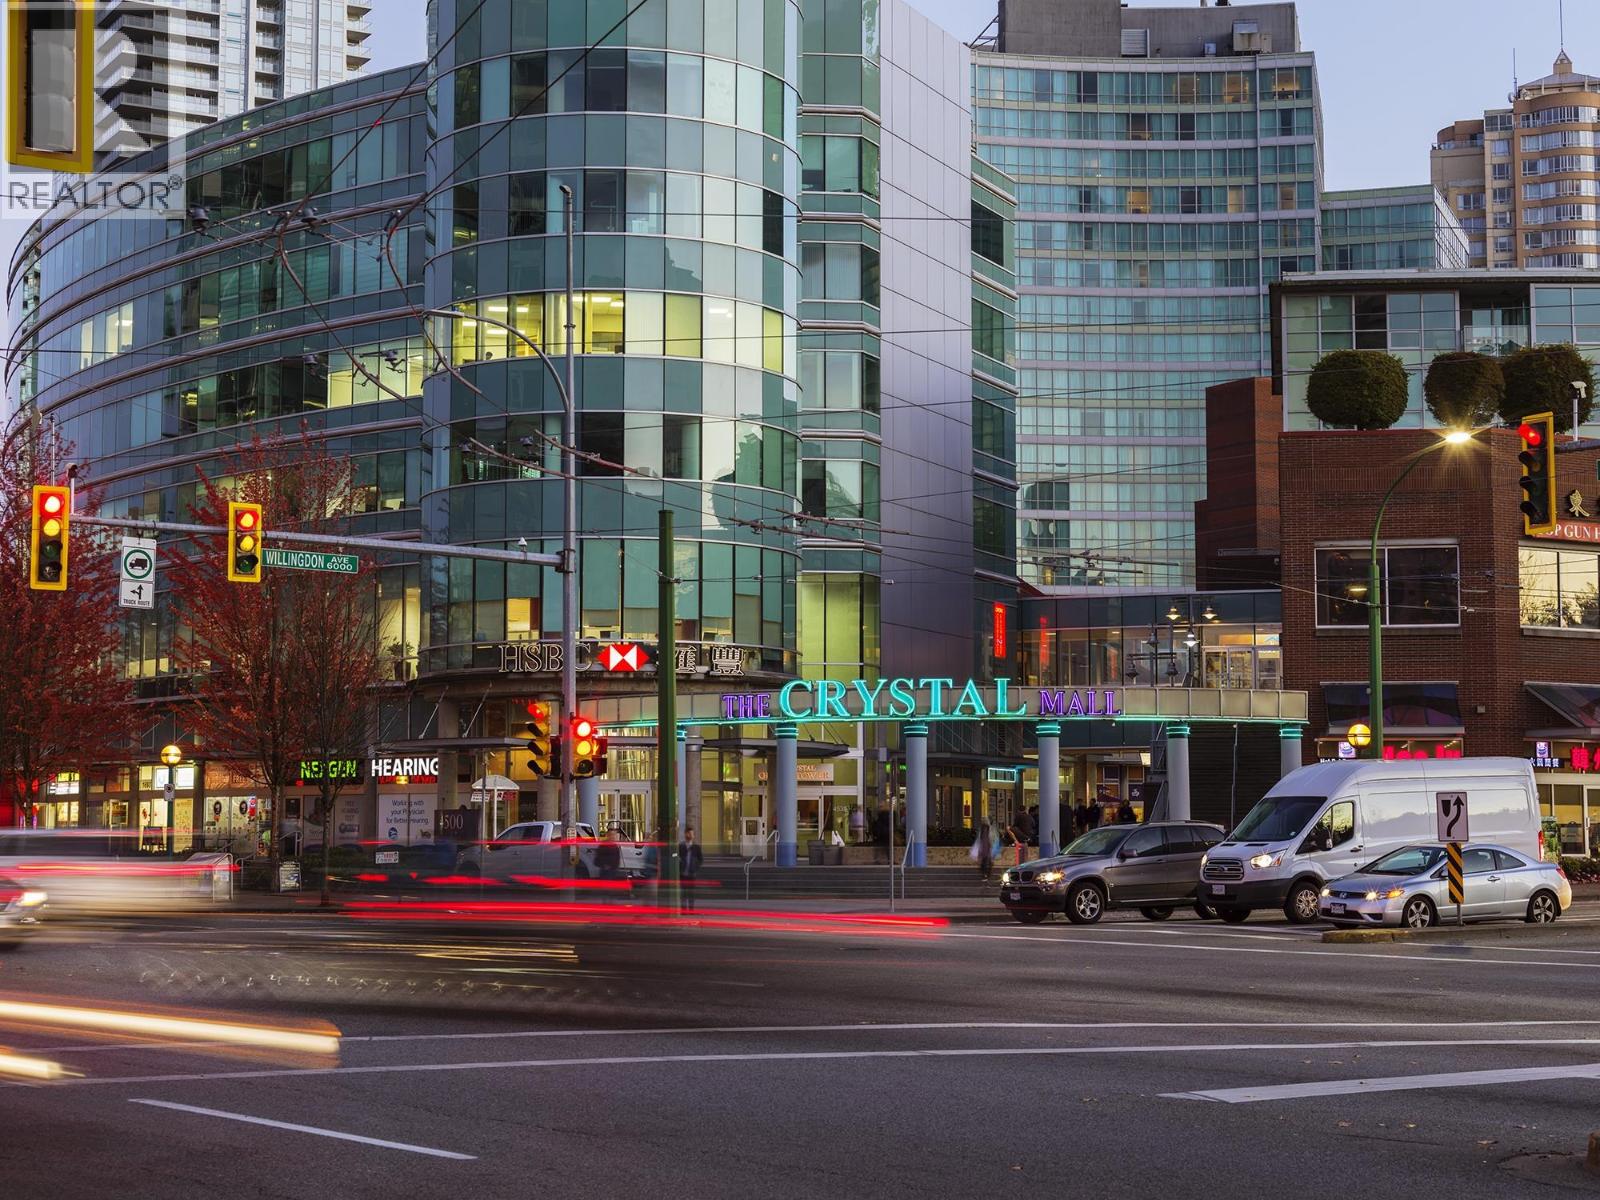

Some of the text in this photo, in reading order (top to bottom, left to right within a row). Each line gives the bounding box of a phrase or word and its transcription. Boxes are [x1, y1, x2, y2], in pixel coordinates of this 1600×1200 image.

[1564, 524, 1591, 540] GUN
[265, 551, 350, 569] WILLINGDON AVE
[326, 562, 353, 571] 6000
[499, 643, 592, 673] HSBC
[722, 677, 1122, 719] THE CRYSTAL MALL
[371, 757, 439, 777] HEARING
